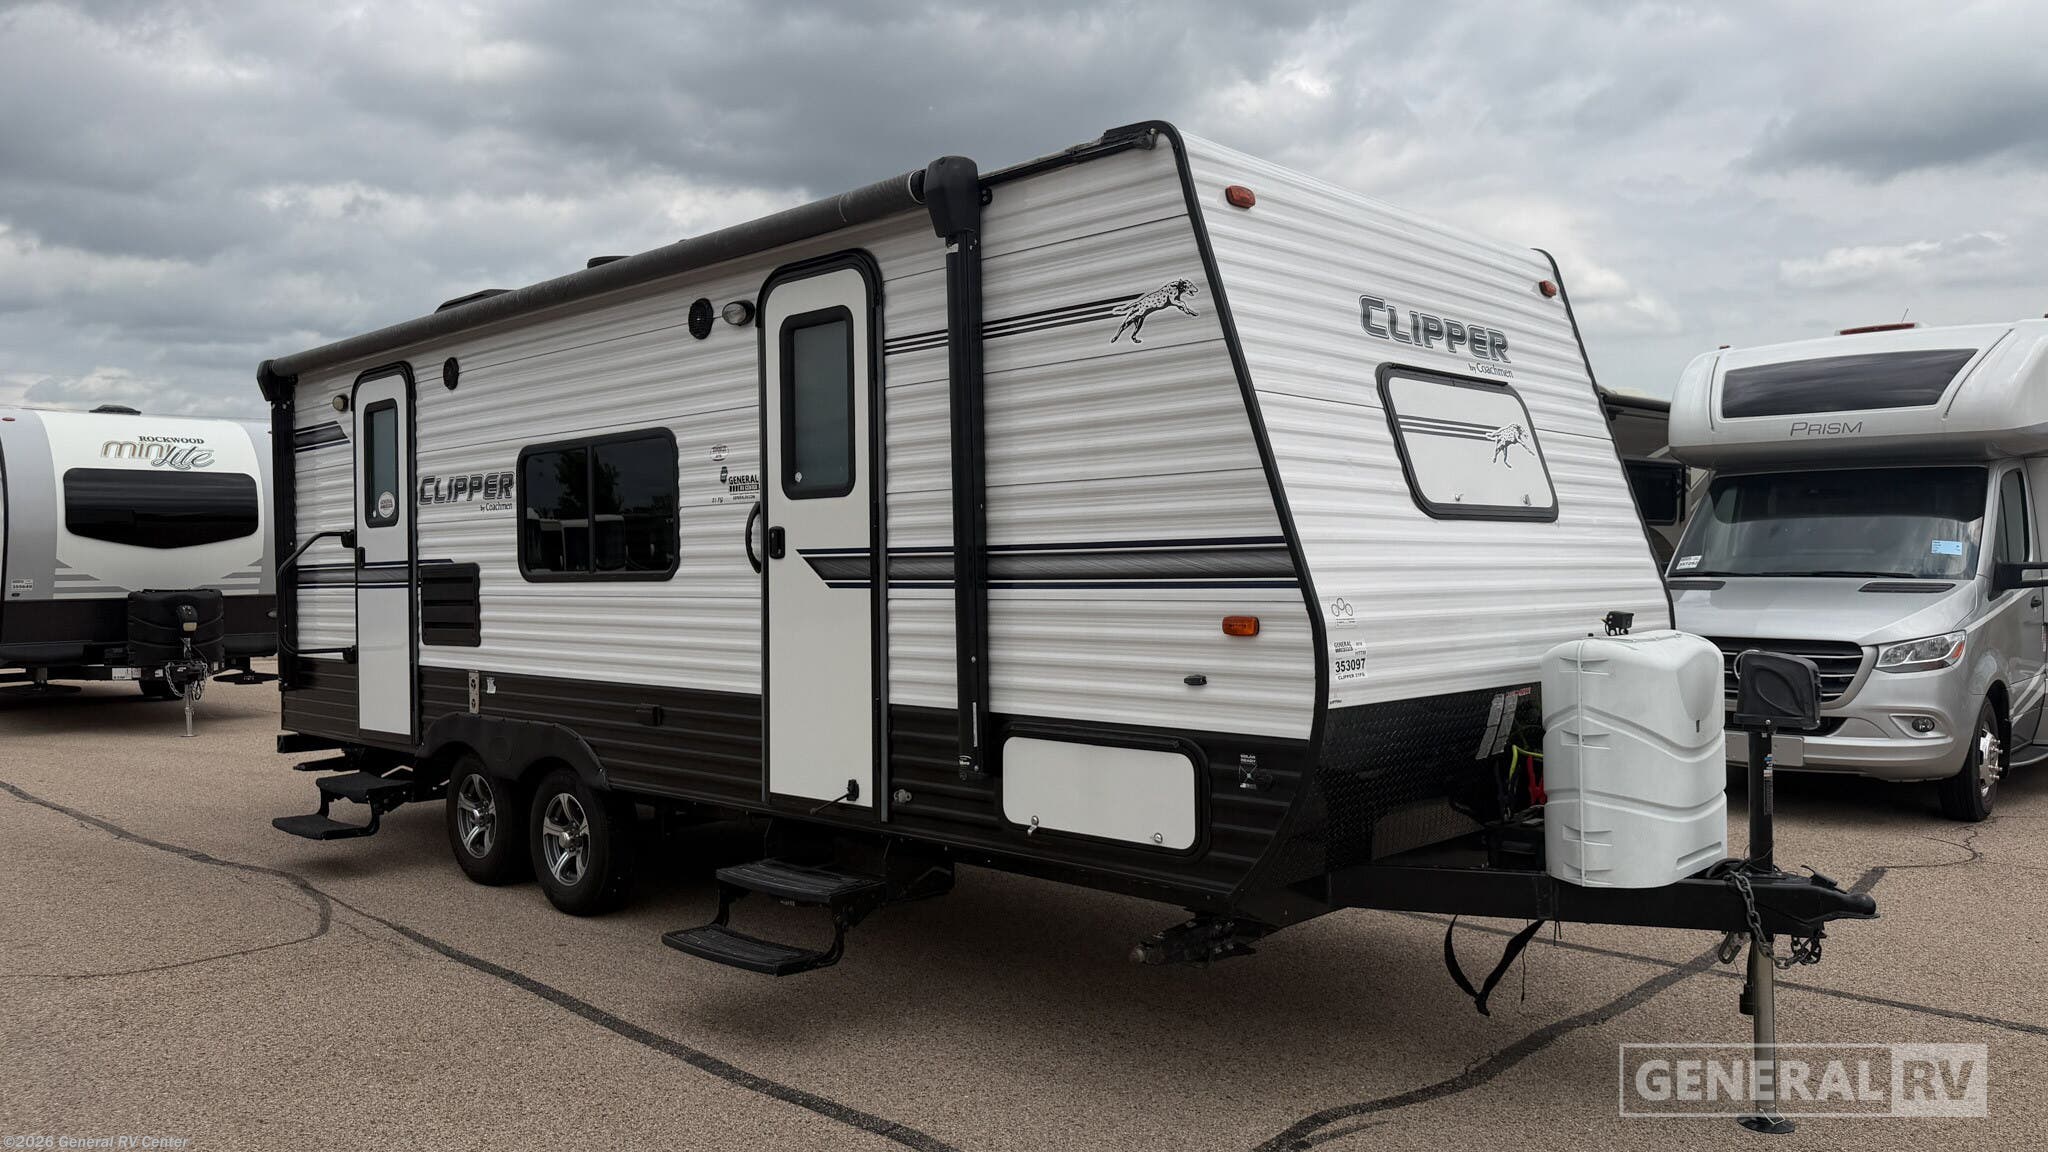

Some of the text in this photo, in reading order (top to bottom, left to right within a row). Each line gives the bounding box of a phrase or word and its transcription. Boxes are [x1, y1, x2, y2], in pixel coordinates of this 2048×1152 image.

[1359, 294, 1511, 363] CLIPPER
[1468, 363, 1514, 378] by Coachmen
[1790, 421, 1863, 437] PRISM
[138, 435, 204, 444] ROCKWOOD
[728, 475, 759, 485] GENERAL
[419, 471, 514, 505] CLIPPER
[485, 501, 512, 512] Coachmen
[1335, 658, 1366, 673] 353097
